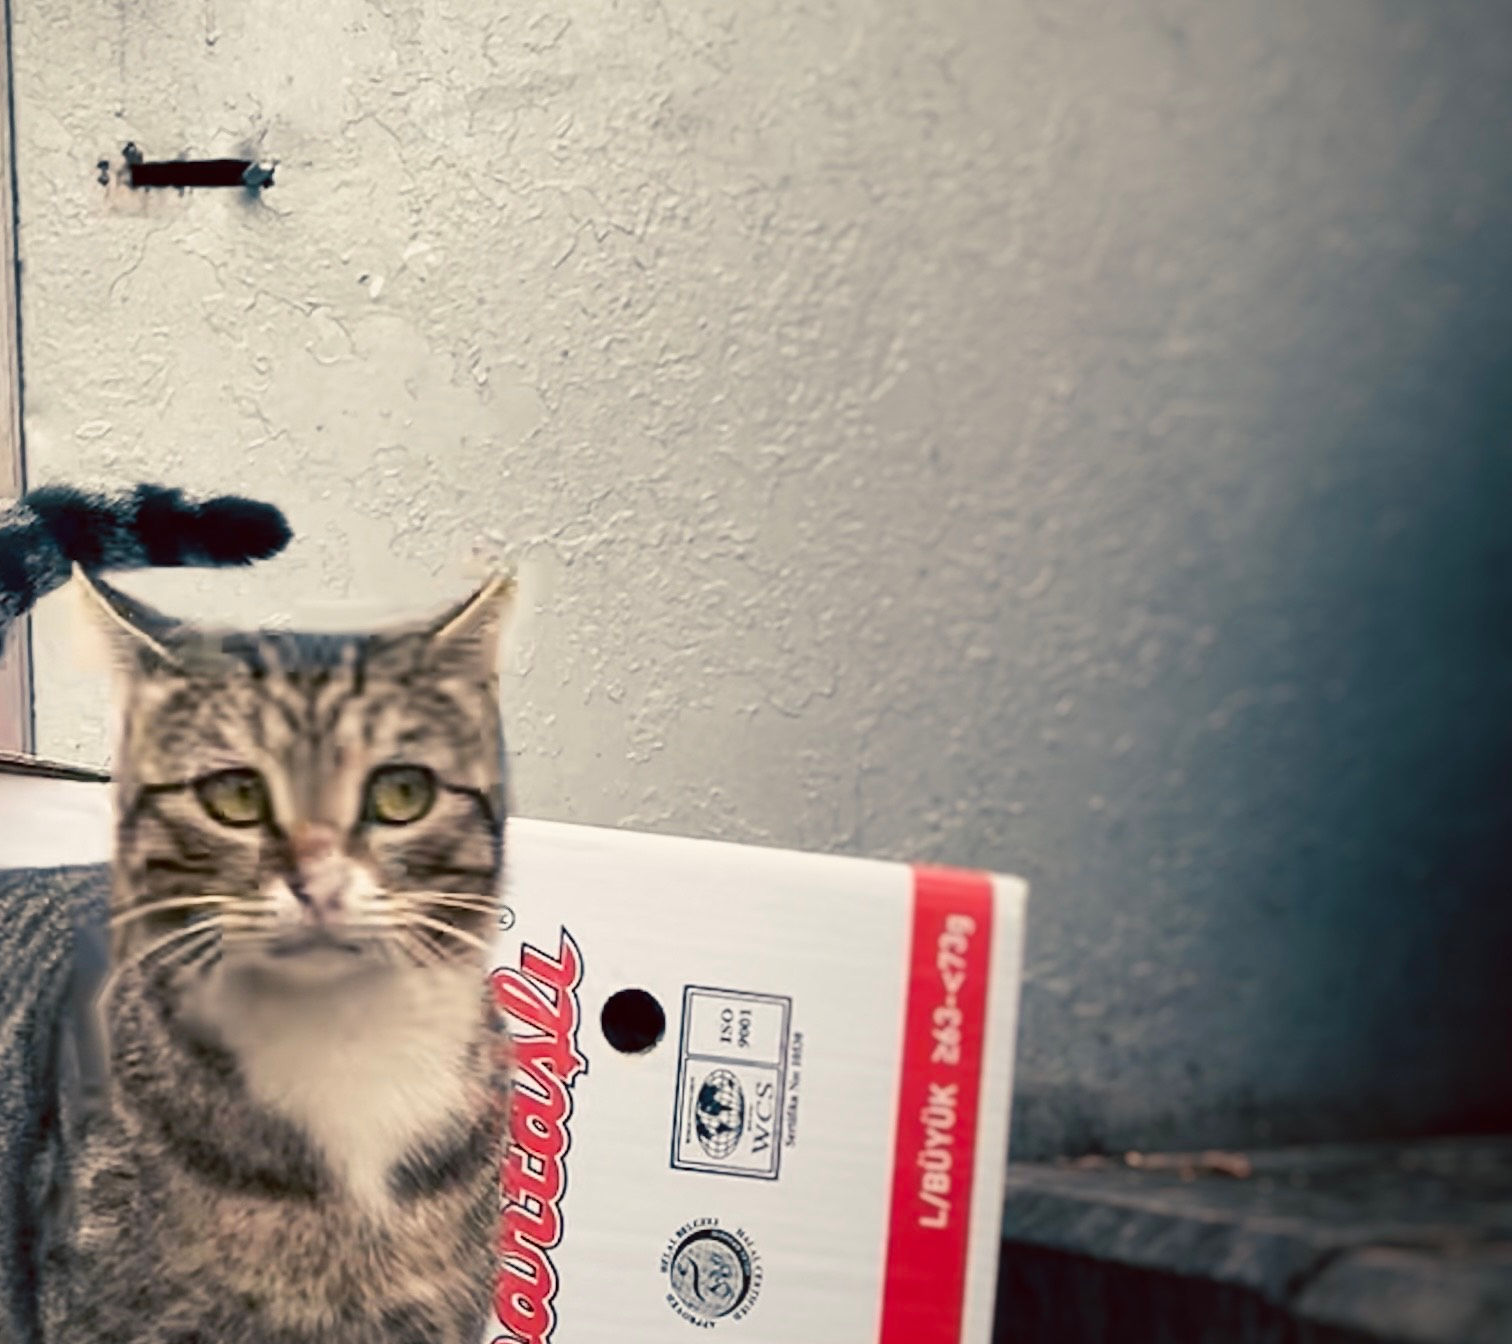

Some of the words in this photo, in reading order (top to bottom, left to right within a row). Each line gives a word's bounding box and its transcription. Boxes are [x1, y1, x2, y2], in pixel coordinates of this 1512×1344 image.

[719, 1007, 734, 1045] ISO
[737, 1008, 752, 1049] 9001
[750, 1080, 775, 1154] WCS
[917, 1084, 961, 1230] L/BÜYÜK
